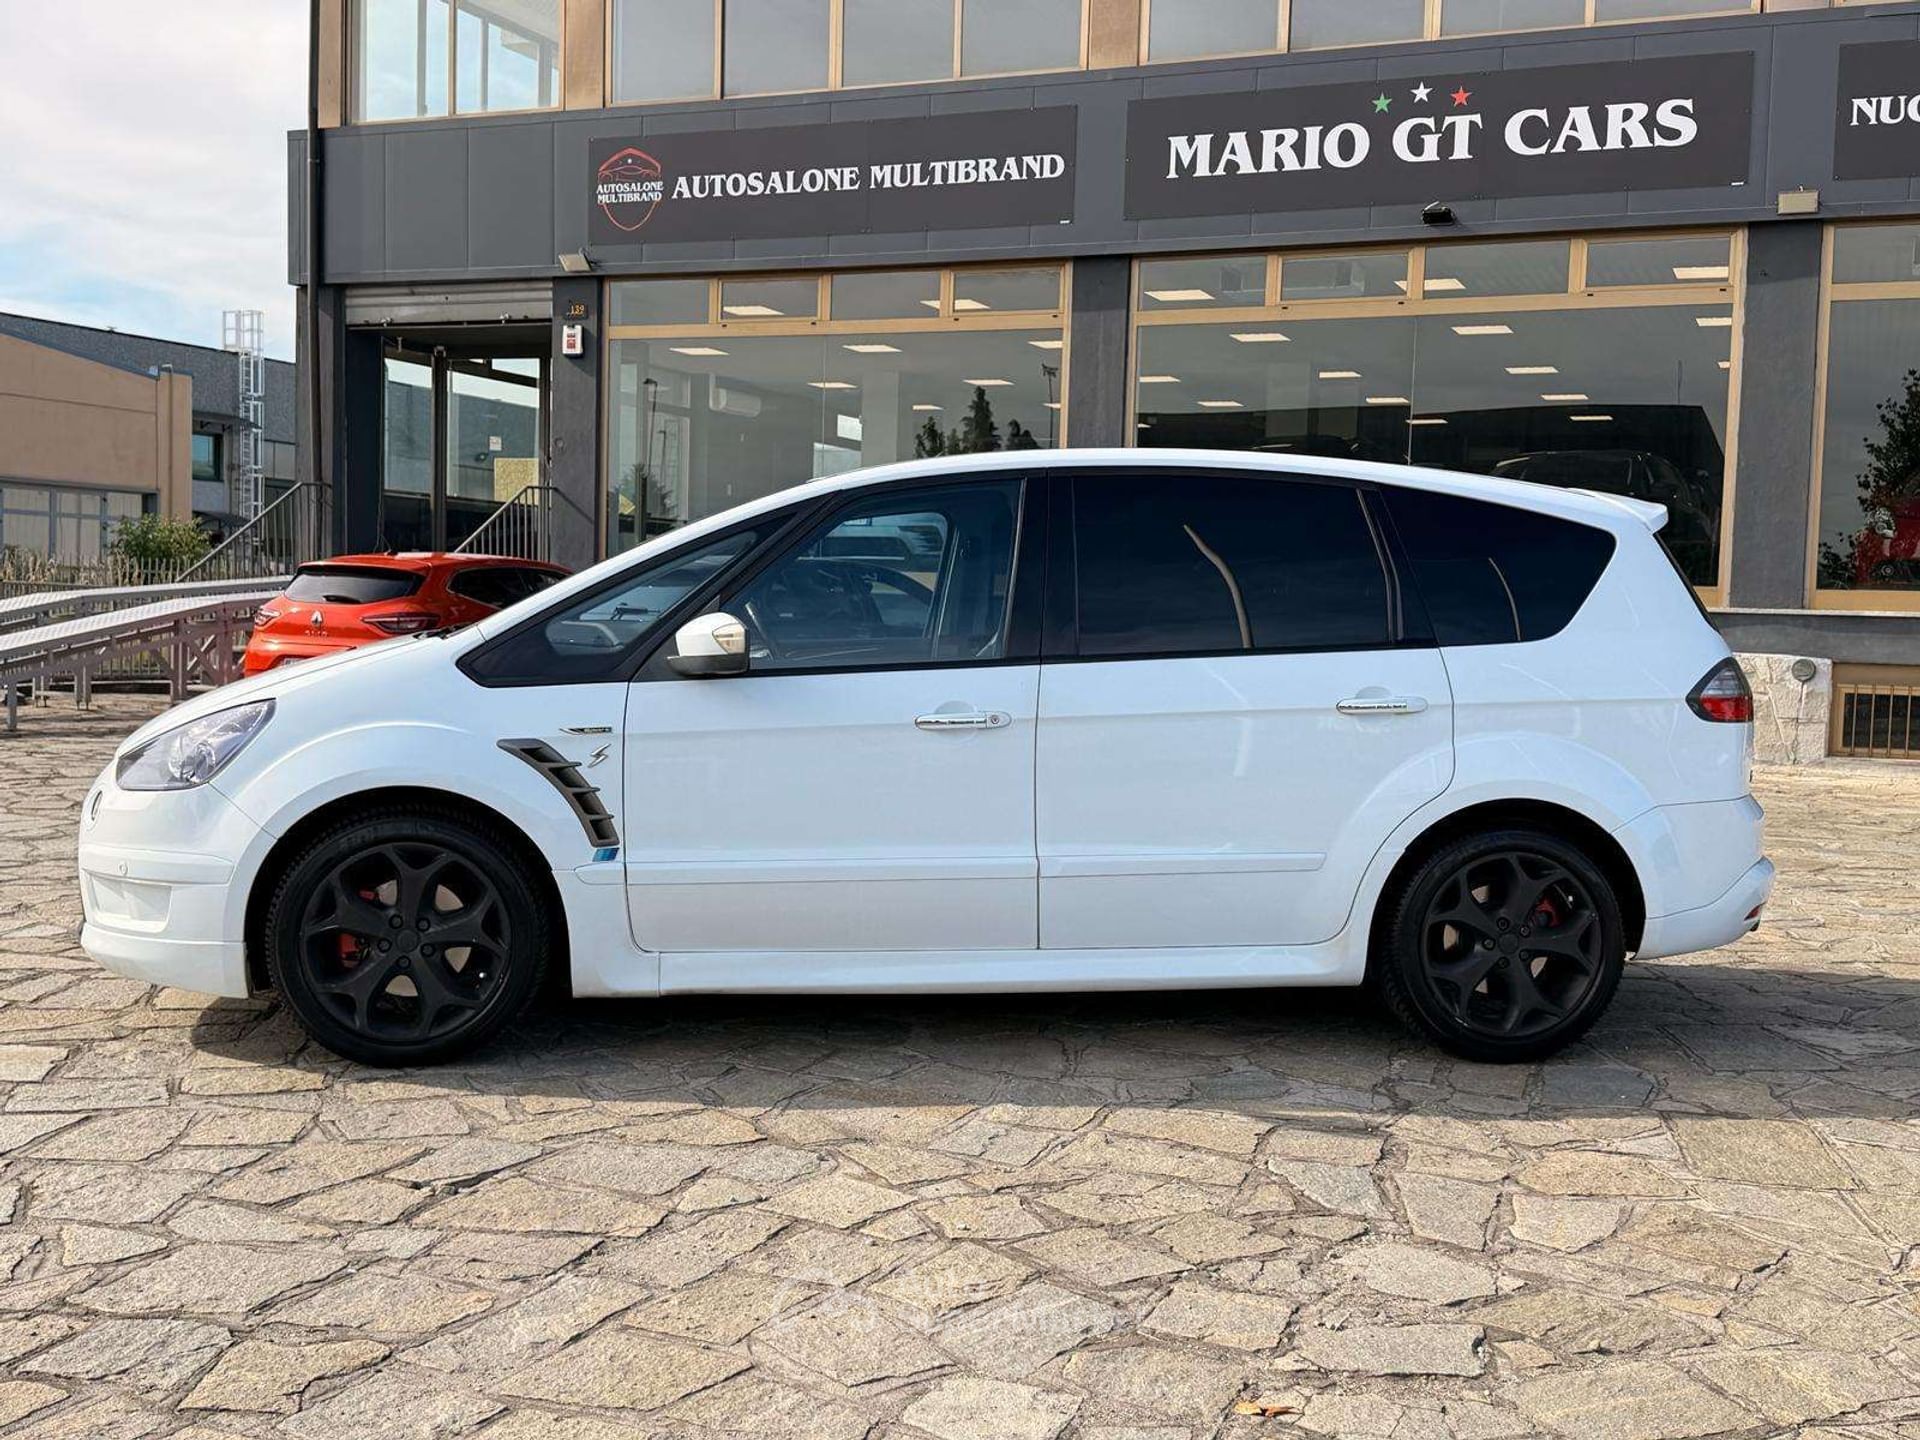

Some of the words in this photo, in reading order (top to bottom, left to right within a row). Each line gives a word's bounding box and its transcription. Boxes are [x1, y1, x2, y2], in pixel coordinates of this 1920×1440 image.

[1166, 122, 1371, 179] MARIO
[1392, 113, 1483, 163] GT
[1504, 98, 1698, 156] CARS
[596, 181, 664, 194] AUTOSALONE
[671, 166, 861, 199] AUTOSALONE
[869, 154, 1065, 189] MULTIBRAND
[597, 191, 663, 205] MULTIBRAND
